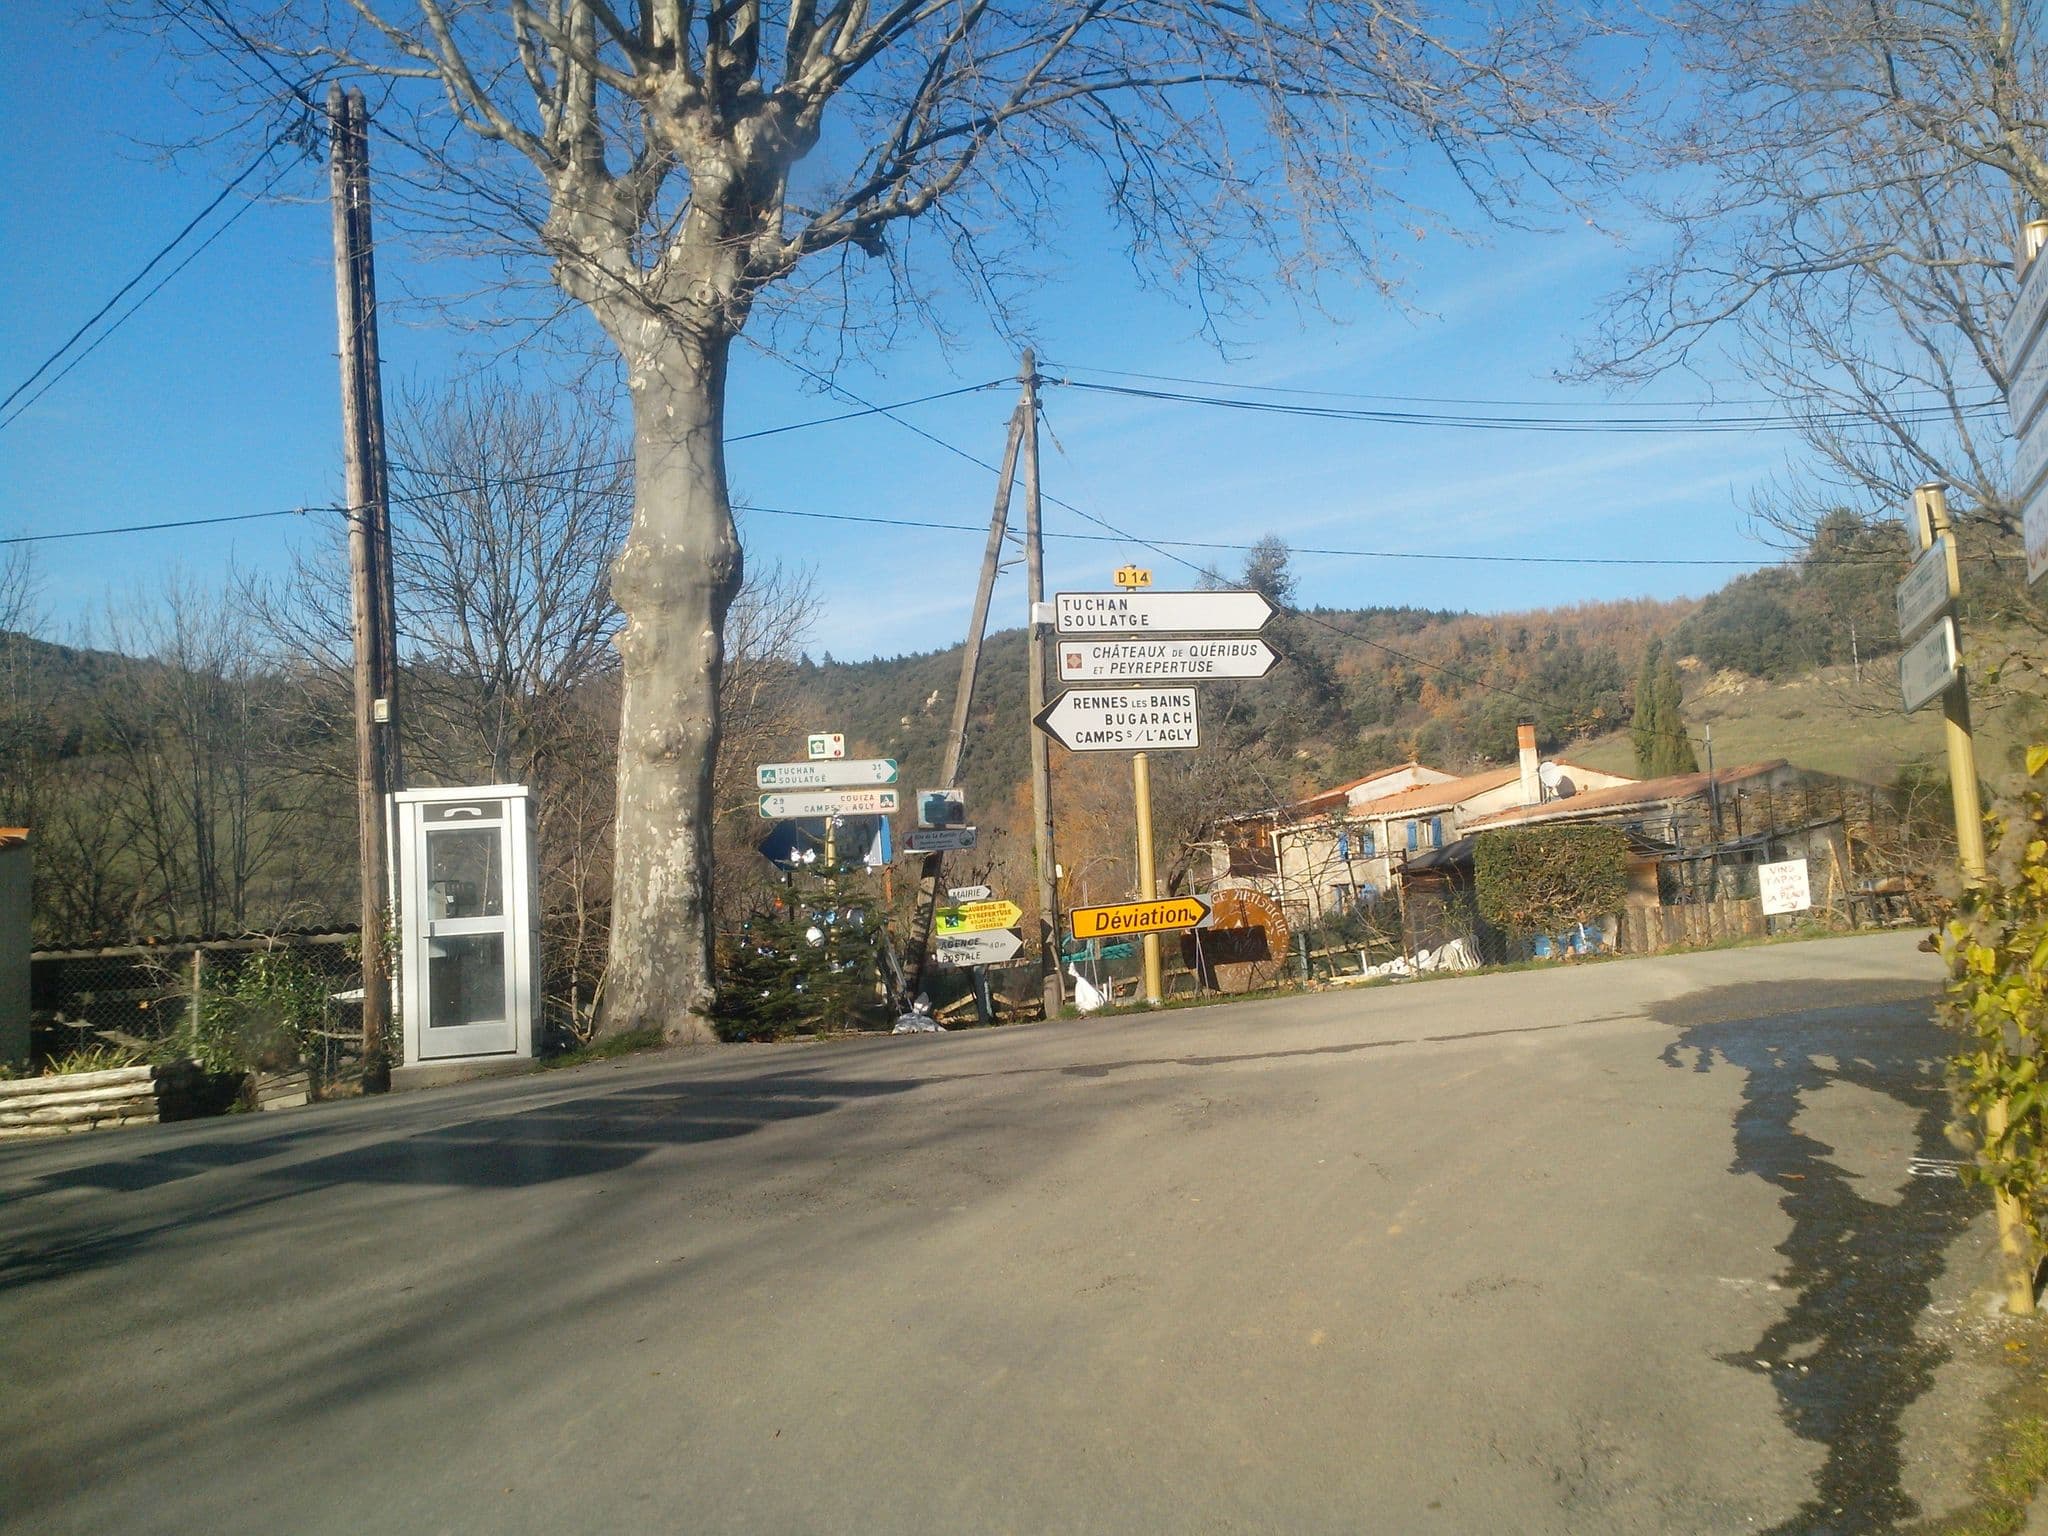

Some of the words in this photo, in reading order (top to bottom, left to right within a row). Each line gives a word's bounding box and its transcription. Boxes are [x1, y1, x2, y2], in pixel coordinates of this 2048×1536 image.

[1118, 571, 1126, 583] D
[1131, 571, 1149, 583] 14
[1063, 599, 1128, 611] TUCHAN
[1064, 613, 1149, 627] SOULATGE
[1092, 643, 1166, 659] CHÂTEAUX
[1171, 648, 1184, 658] DE
[1189, 642, 1258, 657] QUÉRIBUS
[1093, 666, 1104, 675] ET
[1110, 660, 1214, 675] PEYREPERTUSE
[1073, 697, 1128, 710] RENNES
[1131, 698, 1148, 708] LES
[1151, 695, 1191, 708] BAINS
[1105, 712, 1193, 726] BUGARACH
[1075, 730, 1123, 744] CAMPS
[778, 766, 815, 776] TUCHAN
[953, 888, 981, 899] MAIRIE
[1095, 906, 1188, 931] Déviation
[940, 937, 981, 949] AGENCE
[942, 951, 981, 963] POSTALE
